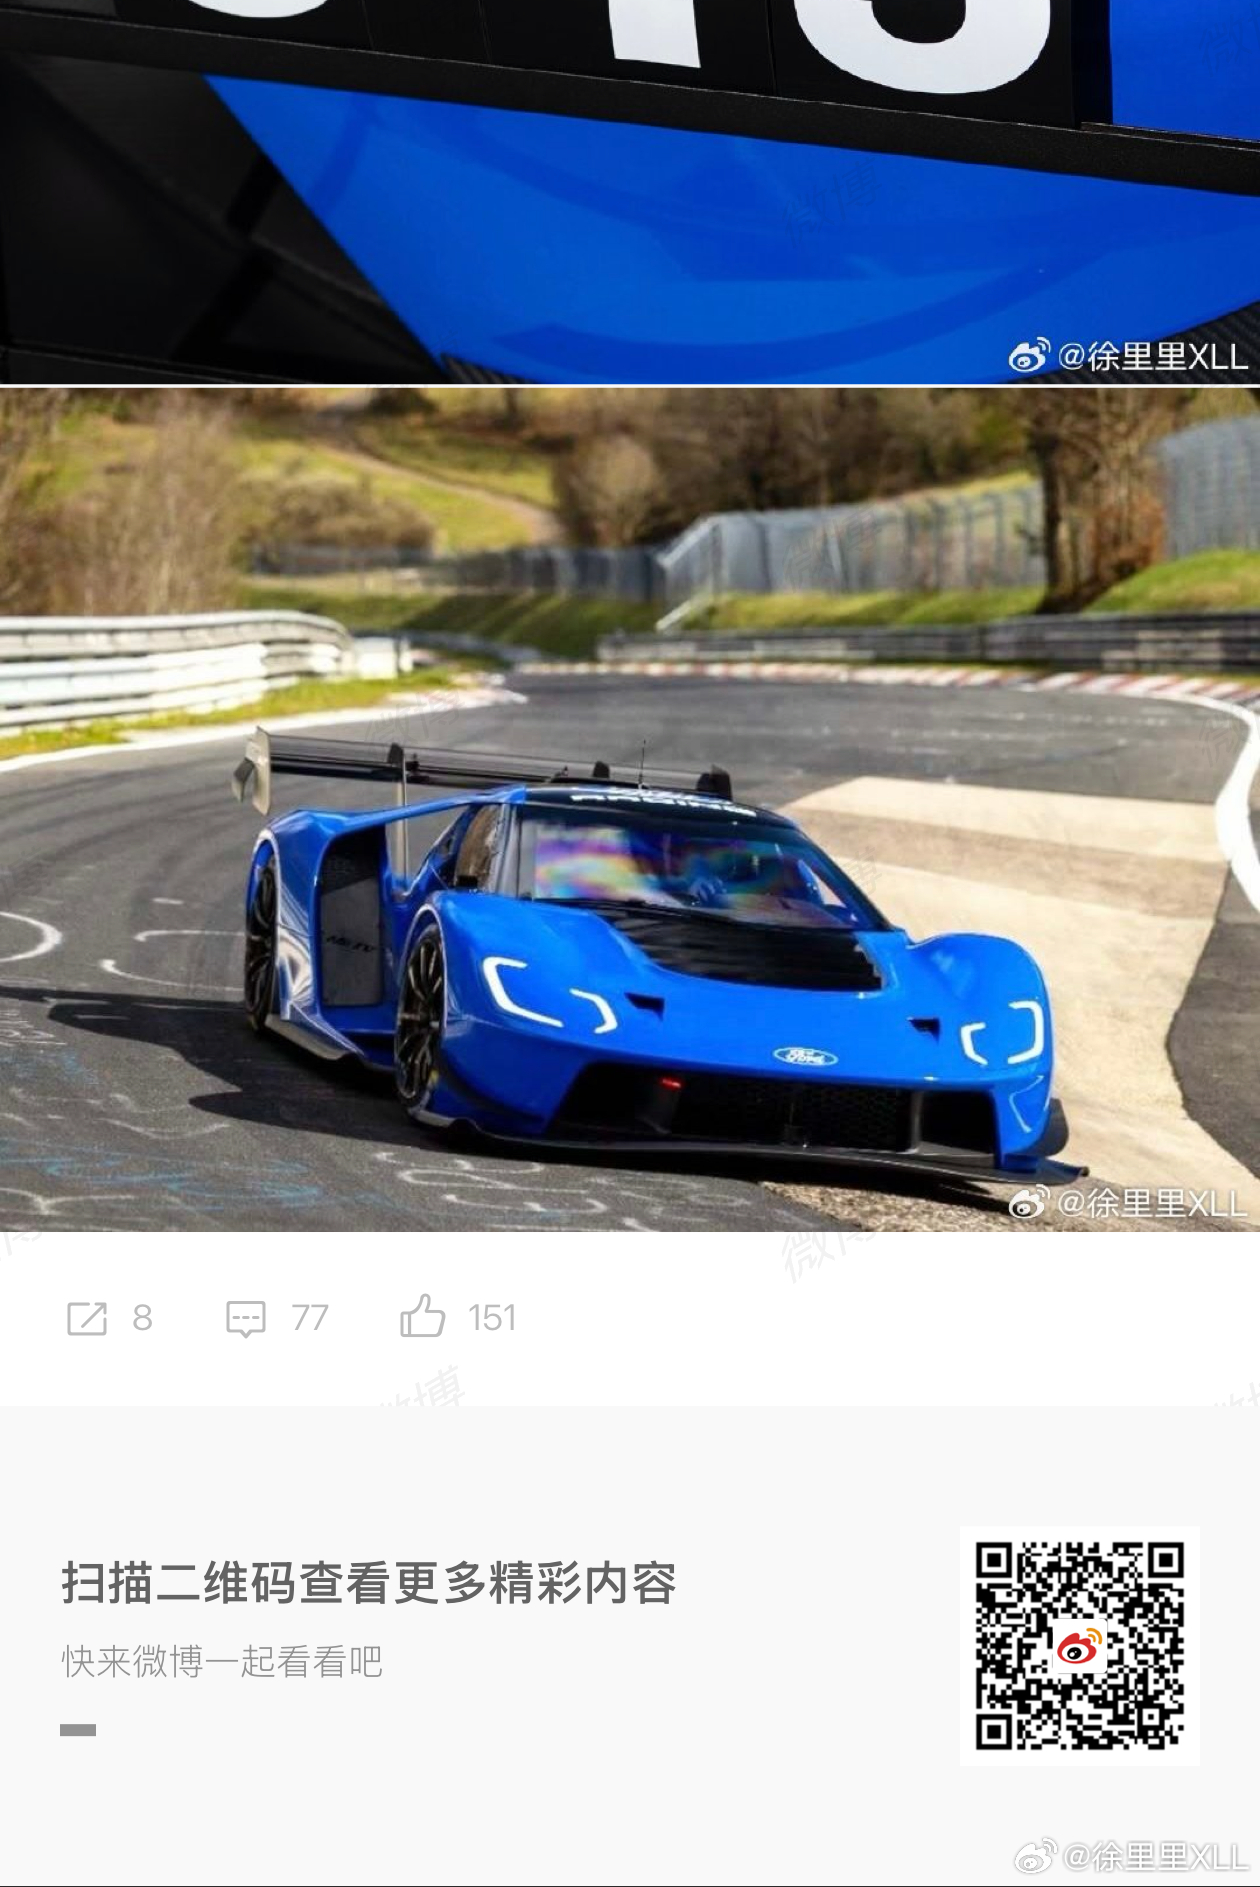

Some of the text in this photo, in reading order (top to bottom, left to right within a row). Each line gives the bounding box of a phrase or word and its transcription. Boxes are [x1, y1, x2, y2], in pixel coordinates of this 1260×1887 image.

[134, 1303, 153, 1331] 8
[292, 1304, 329, 1331] 77
[469, 1303, 514, 1331] 151
[62, 1560, 676, 1604] 扫描二维码查看更多精彩内容
[62, 1645, 383, 1678] 快来微博一起看看吧
